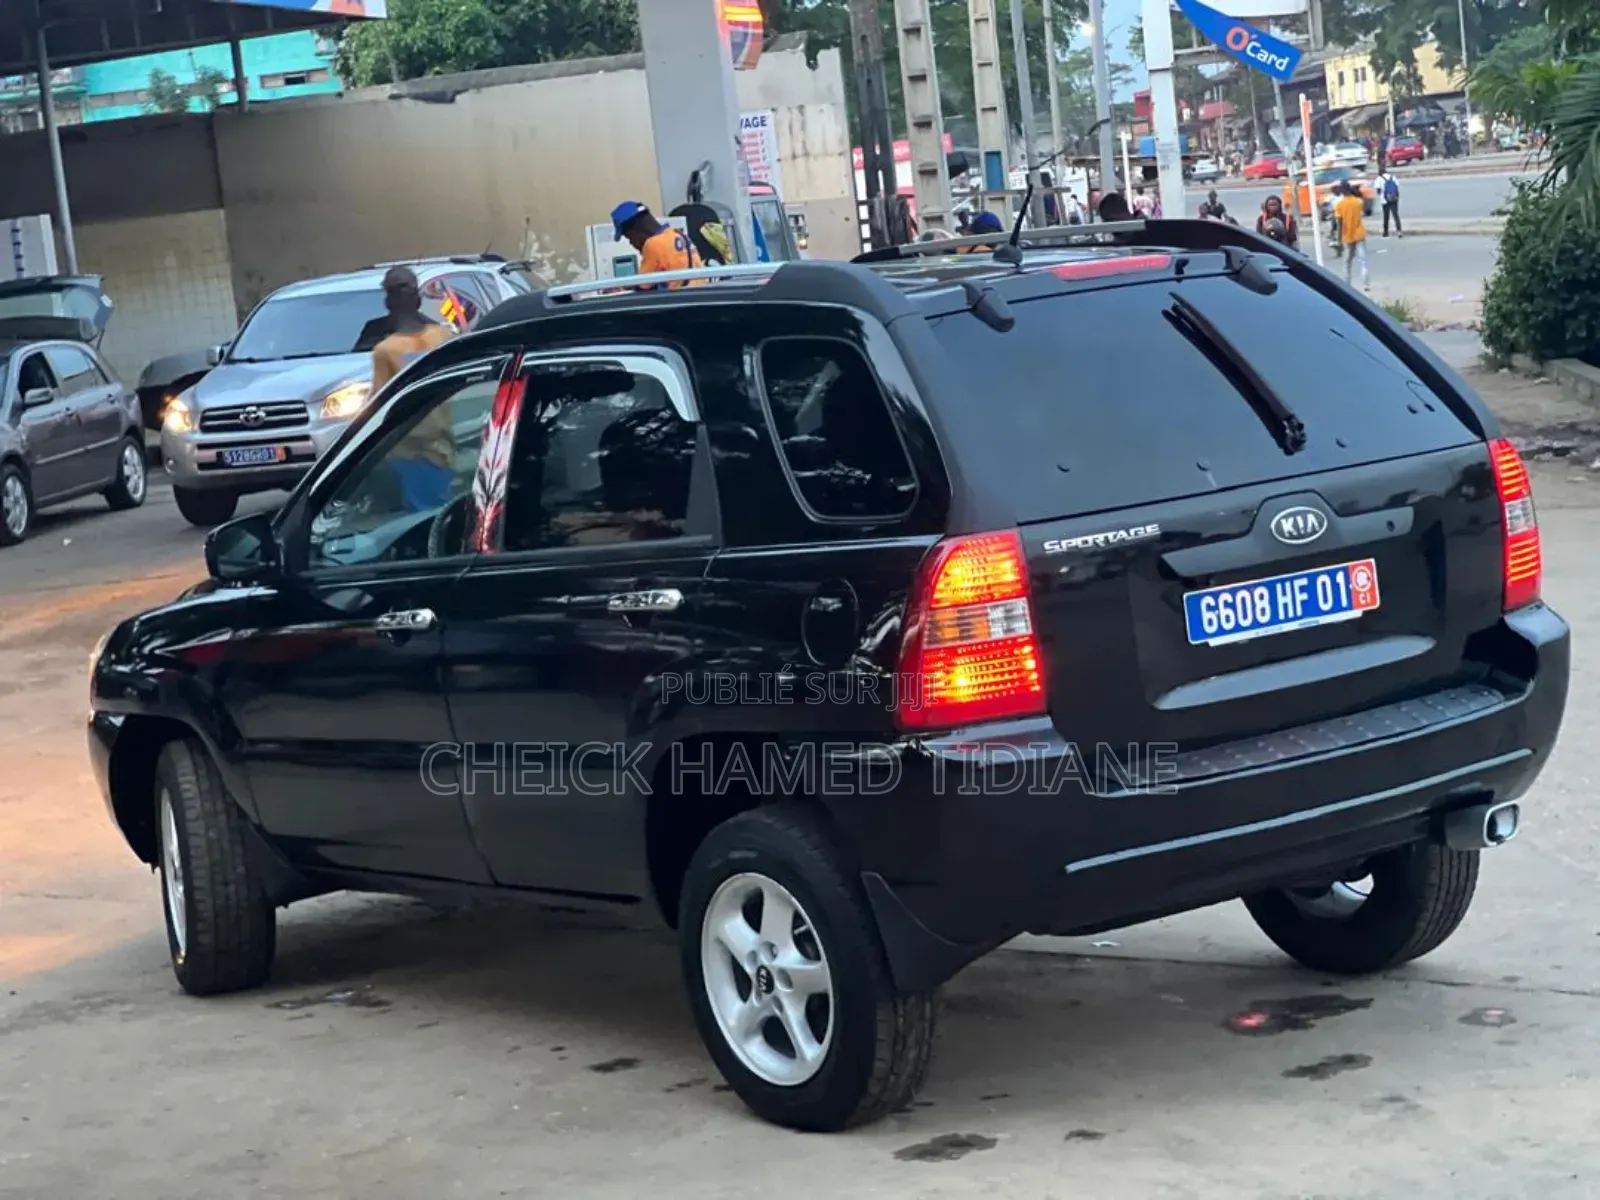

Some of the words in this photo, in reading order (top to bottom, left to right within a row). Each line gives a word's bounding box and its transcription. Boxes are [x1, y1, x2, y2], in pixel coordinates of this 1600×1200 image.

[1226, 26, 1290, 72] O'Card
[1043, 523, 1160, 554] SPORTAGE
[1280, 513, 1320, 537] KIA
[1201, 586, 1271, 634] 6608
[1275, 577, 1309, 620] HF
[1316, 570, 1348, 612] 01
[1359, 592, 1371, 605] CI
